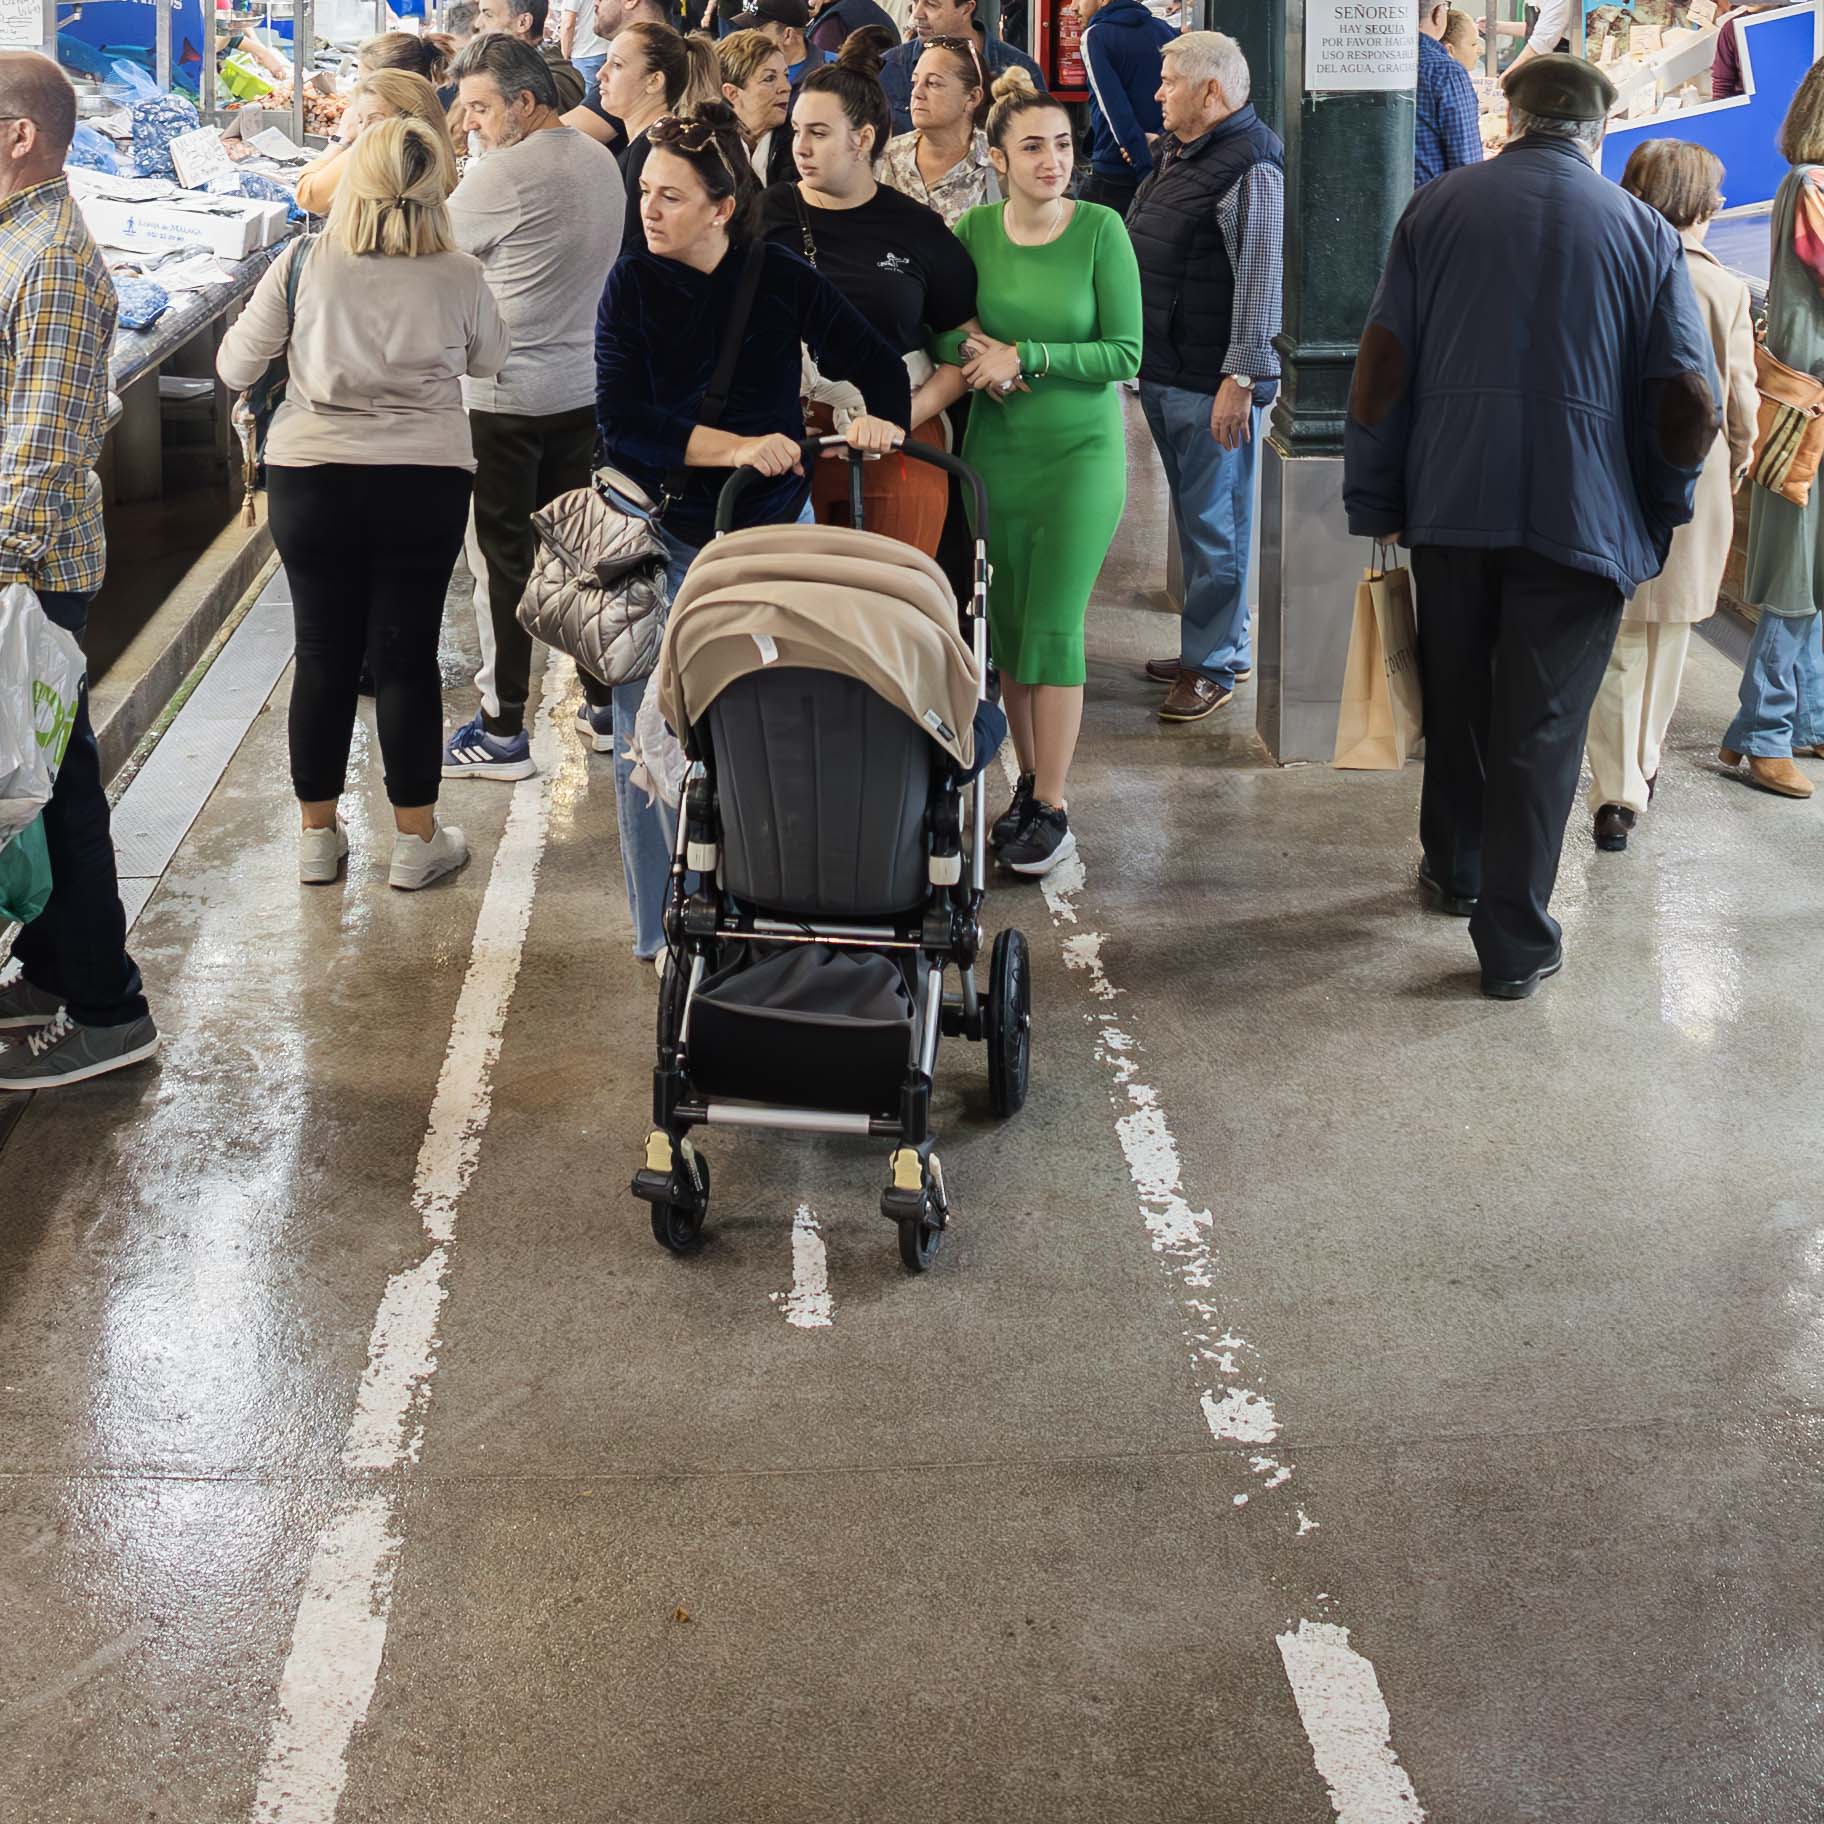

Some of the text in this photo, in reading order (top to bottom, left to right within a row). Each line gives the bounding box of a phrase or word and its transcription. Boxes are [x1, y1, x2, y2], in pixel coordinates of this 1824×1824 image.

[1339, 25, 1361, 33] HAY
[1322, 37, 1343, 47] POR
[1346, 37, 1382, 47] FAVOR
[1322, 50, 1344, 60] USO
[1316, 64, 1338, 73] DEL
